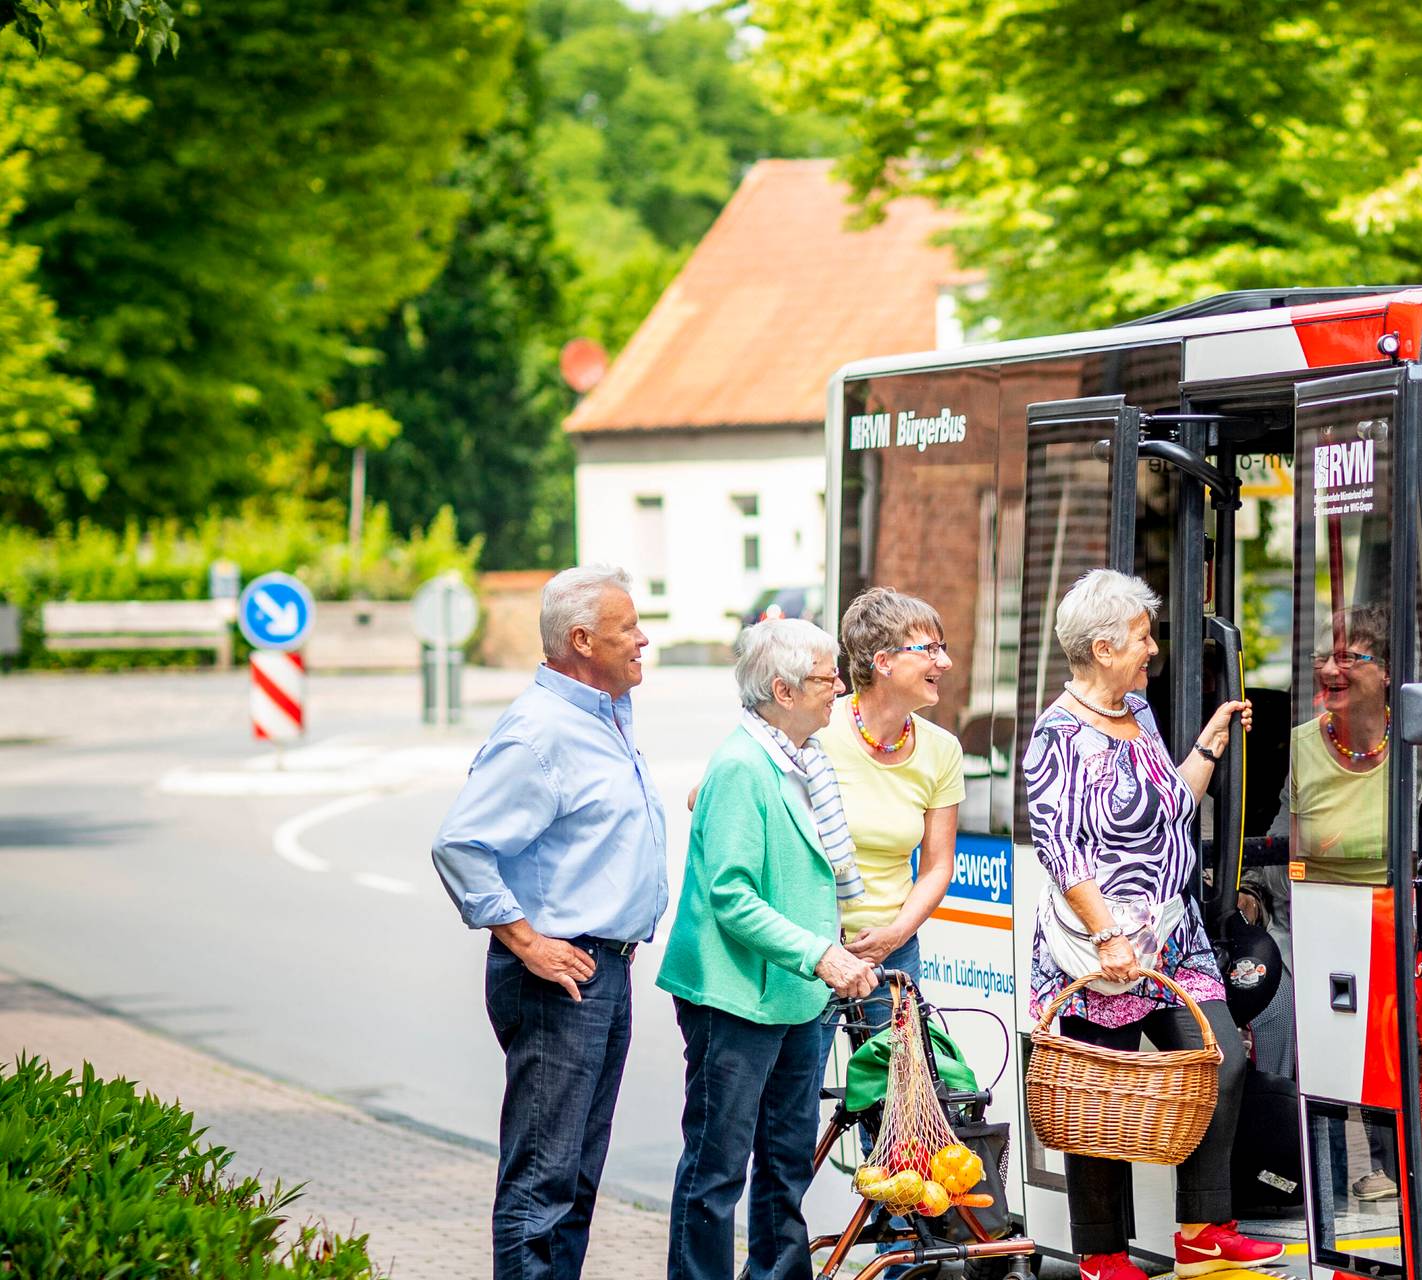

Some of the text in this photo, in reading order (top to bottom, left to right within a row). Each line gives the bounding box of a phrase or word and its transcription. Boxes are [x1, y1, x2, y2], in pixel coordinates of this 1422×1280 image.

[862, 408, 967, 452] RVM BürgerBus
[1329, 439, 1374, 487] RVM
[942, 956, 952, 983] in
